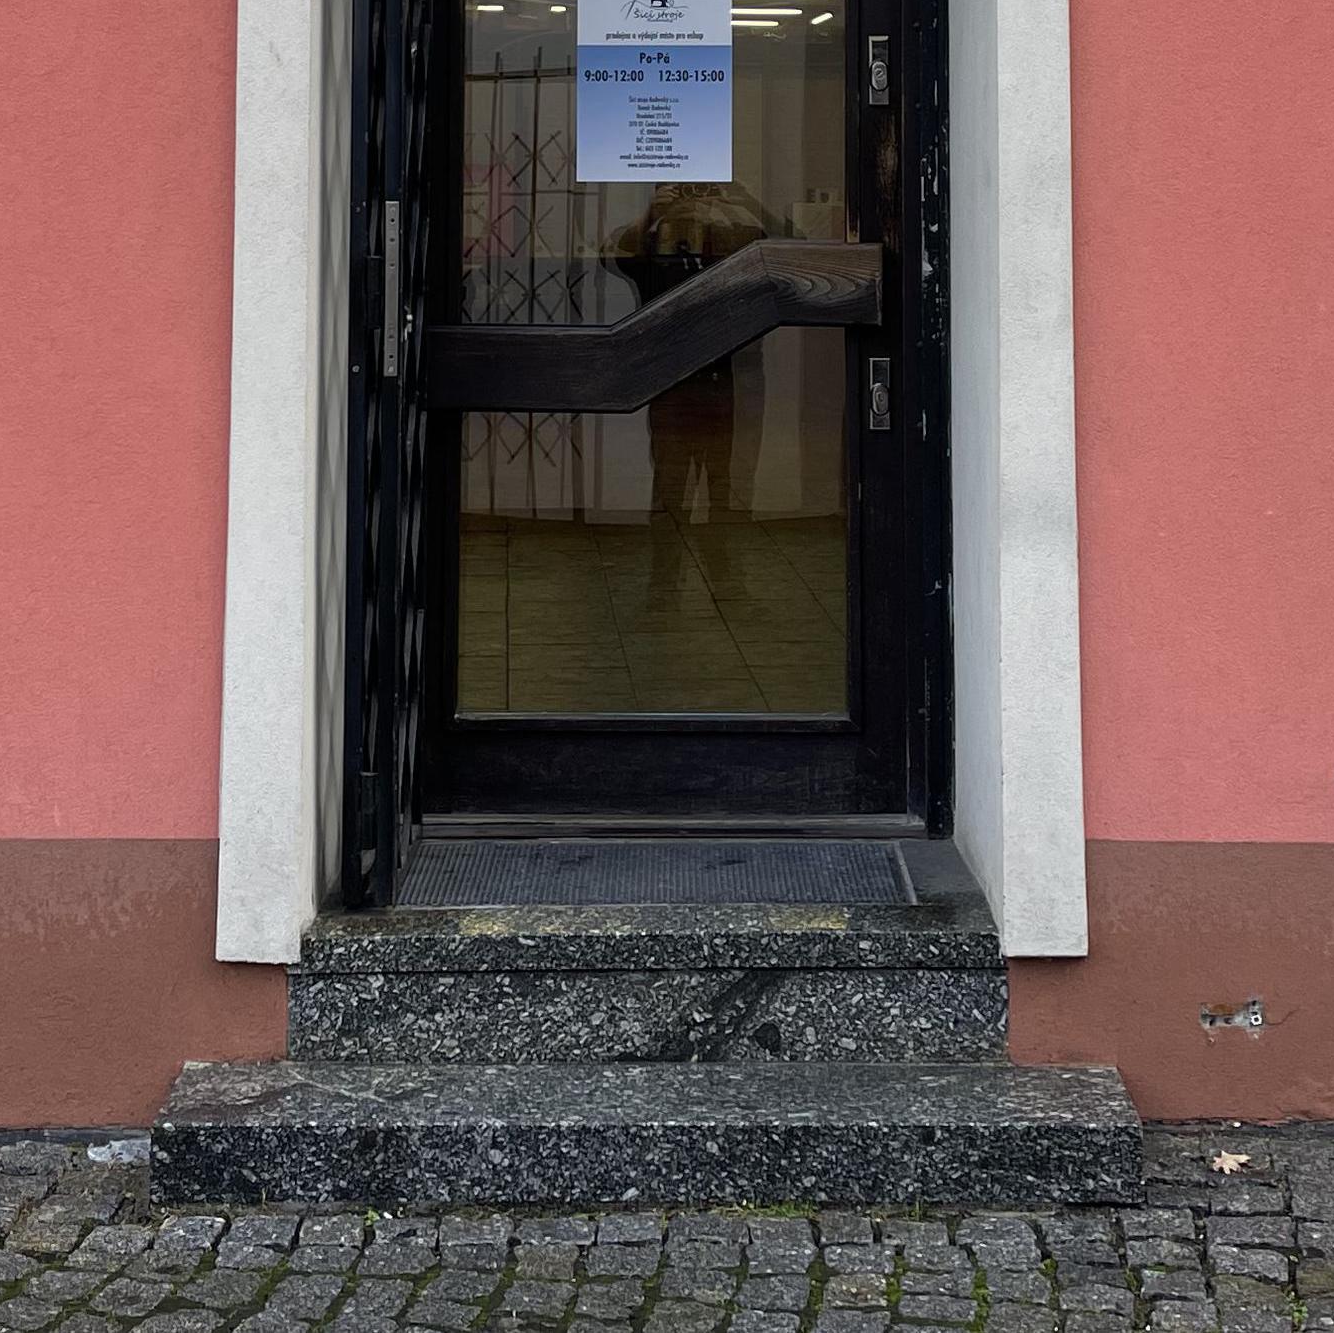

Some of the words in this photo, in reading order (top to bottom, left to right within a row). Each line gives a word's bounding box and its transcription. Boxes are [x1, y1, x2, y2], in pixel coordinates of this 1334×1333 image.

[639, 52, 670, 64] Po-Pá
[584, 70, 644, 82] 9:00-12:00
[658, 70, 725, 82] 12:30-15:00
